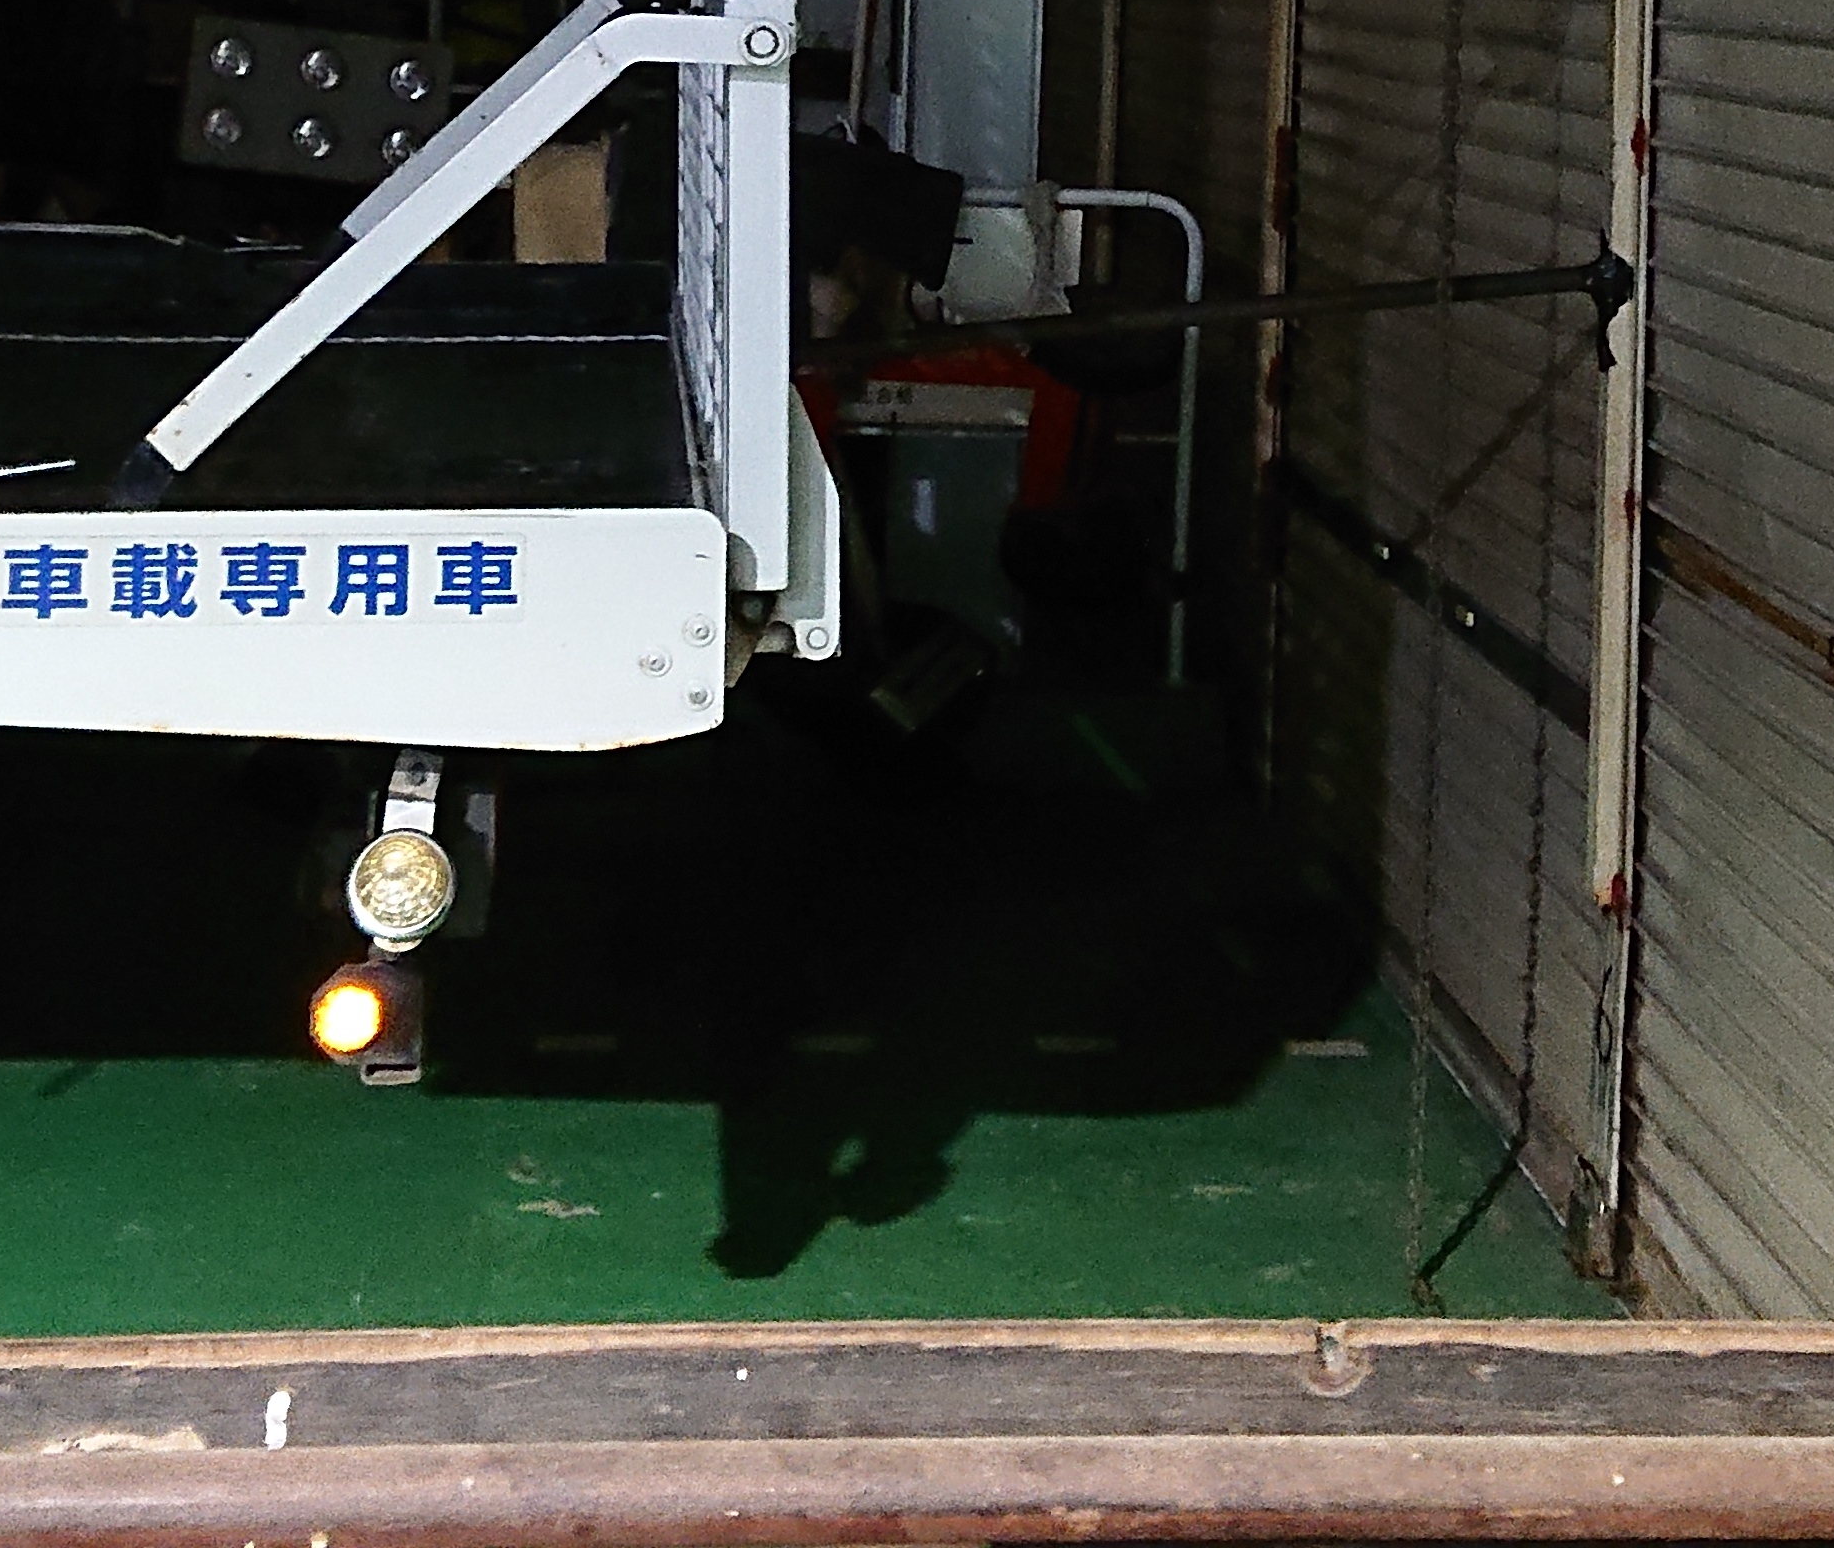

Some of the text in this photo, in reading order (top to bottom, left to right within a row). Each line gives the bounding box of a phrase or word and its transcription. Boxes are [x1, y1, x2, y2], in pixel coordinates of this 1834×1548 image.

[1, 542, 519, 620] 車載専用車
